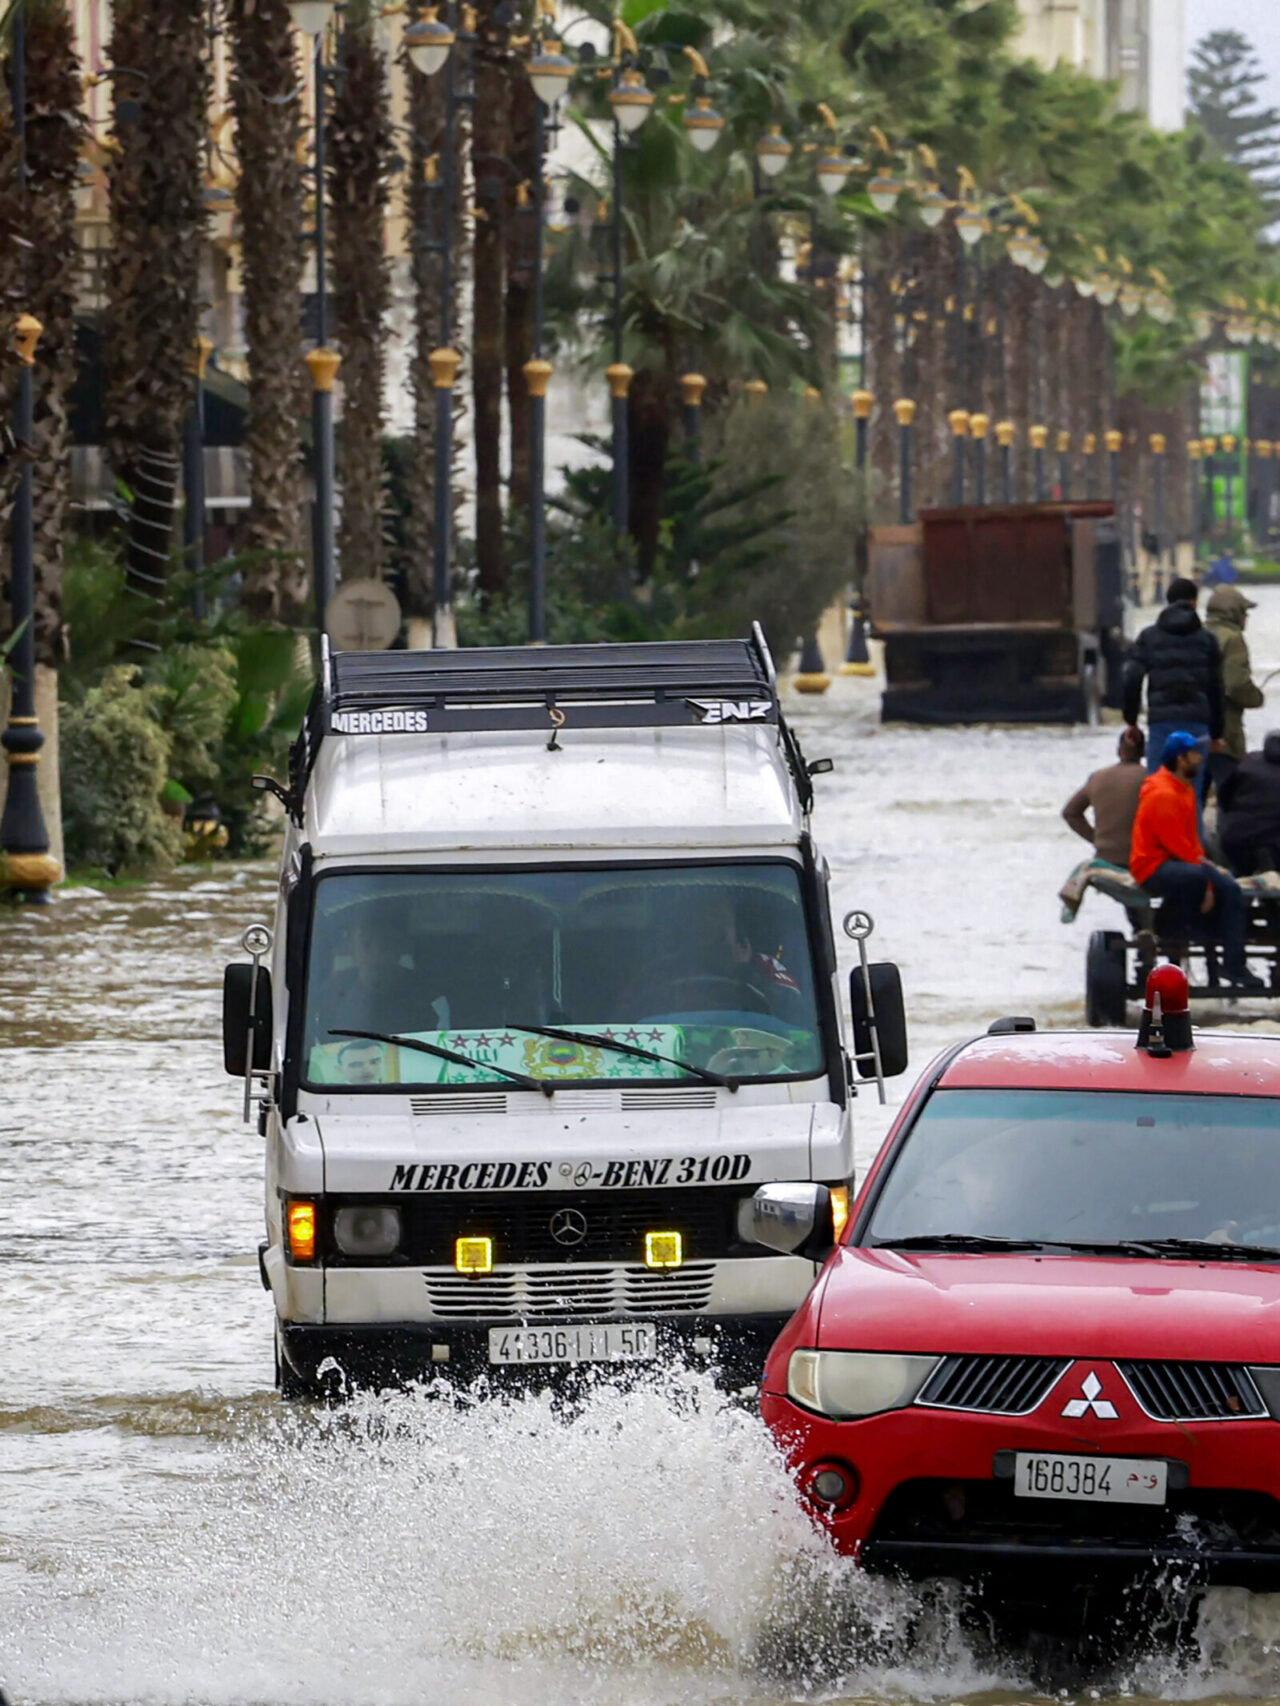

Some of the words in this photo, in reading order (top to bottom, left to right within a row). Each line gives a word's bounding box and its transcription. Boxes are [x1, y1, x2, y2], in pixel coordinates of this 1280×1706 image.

[331, 711, 428, 733] MERCEDES
[701, 701, 773, 724] ENZ
[389, 1162, 552, 1191] MERCEDES
[676, 1154, 752, 1183] 310D
[1027, 1459, 1112, 1496] 168384
